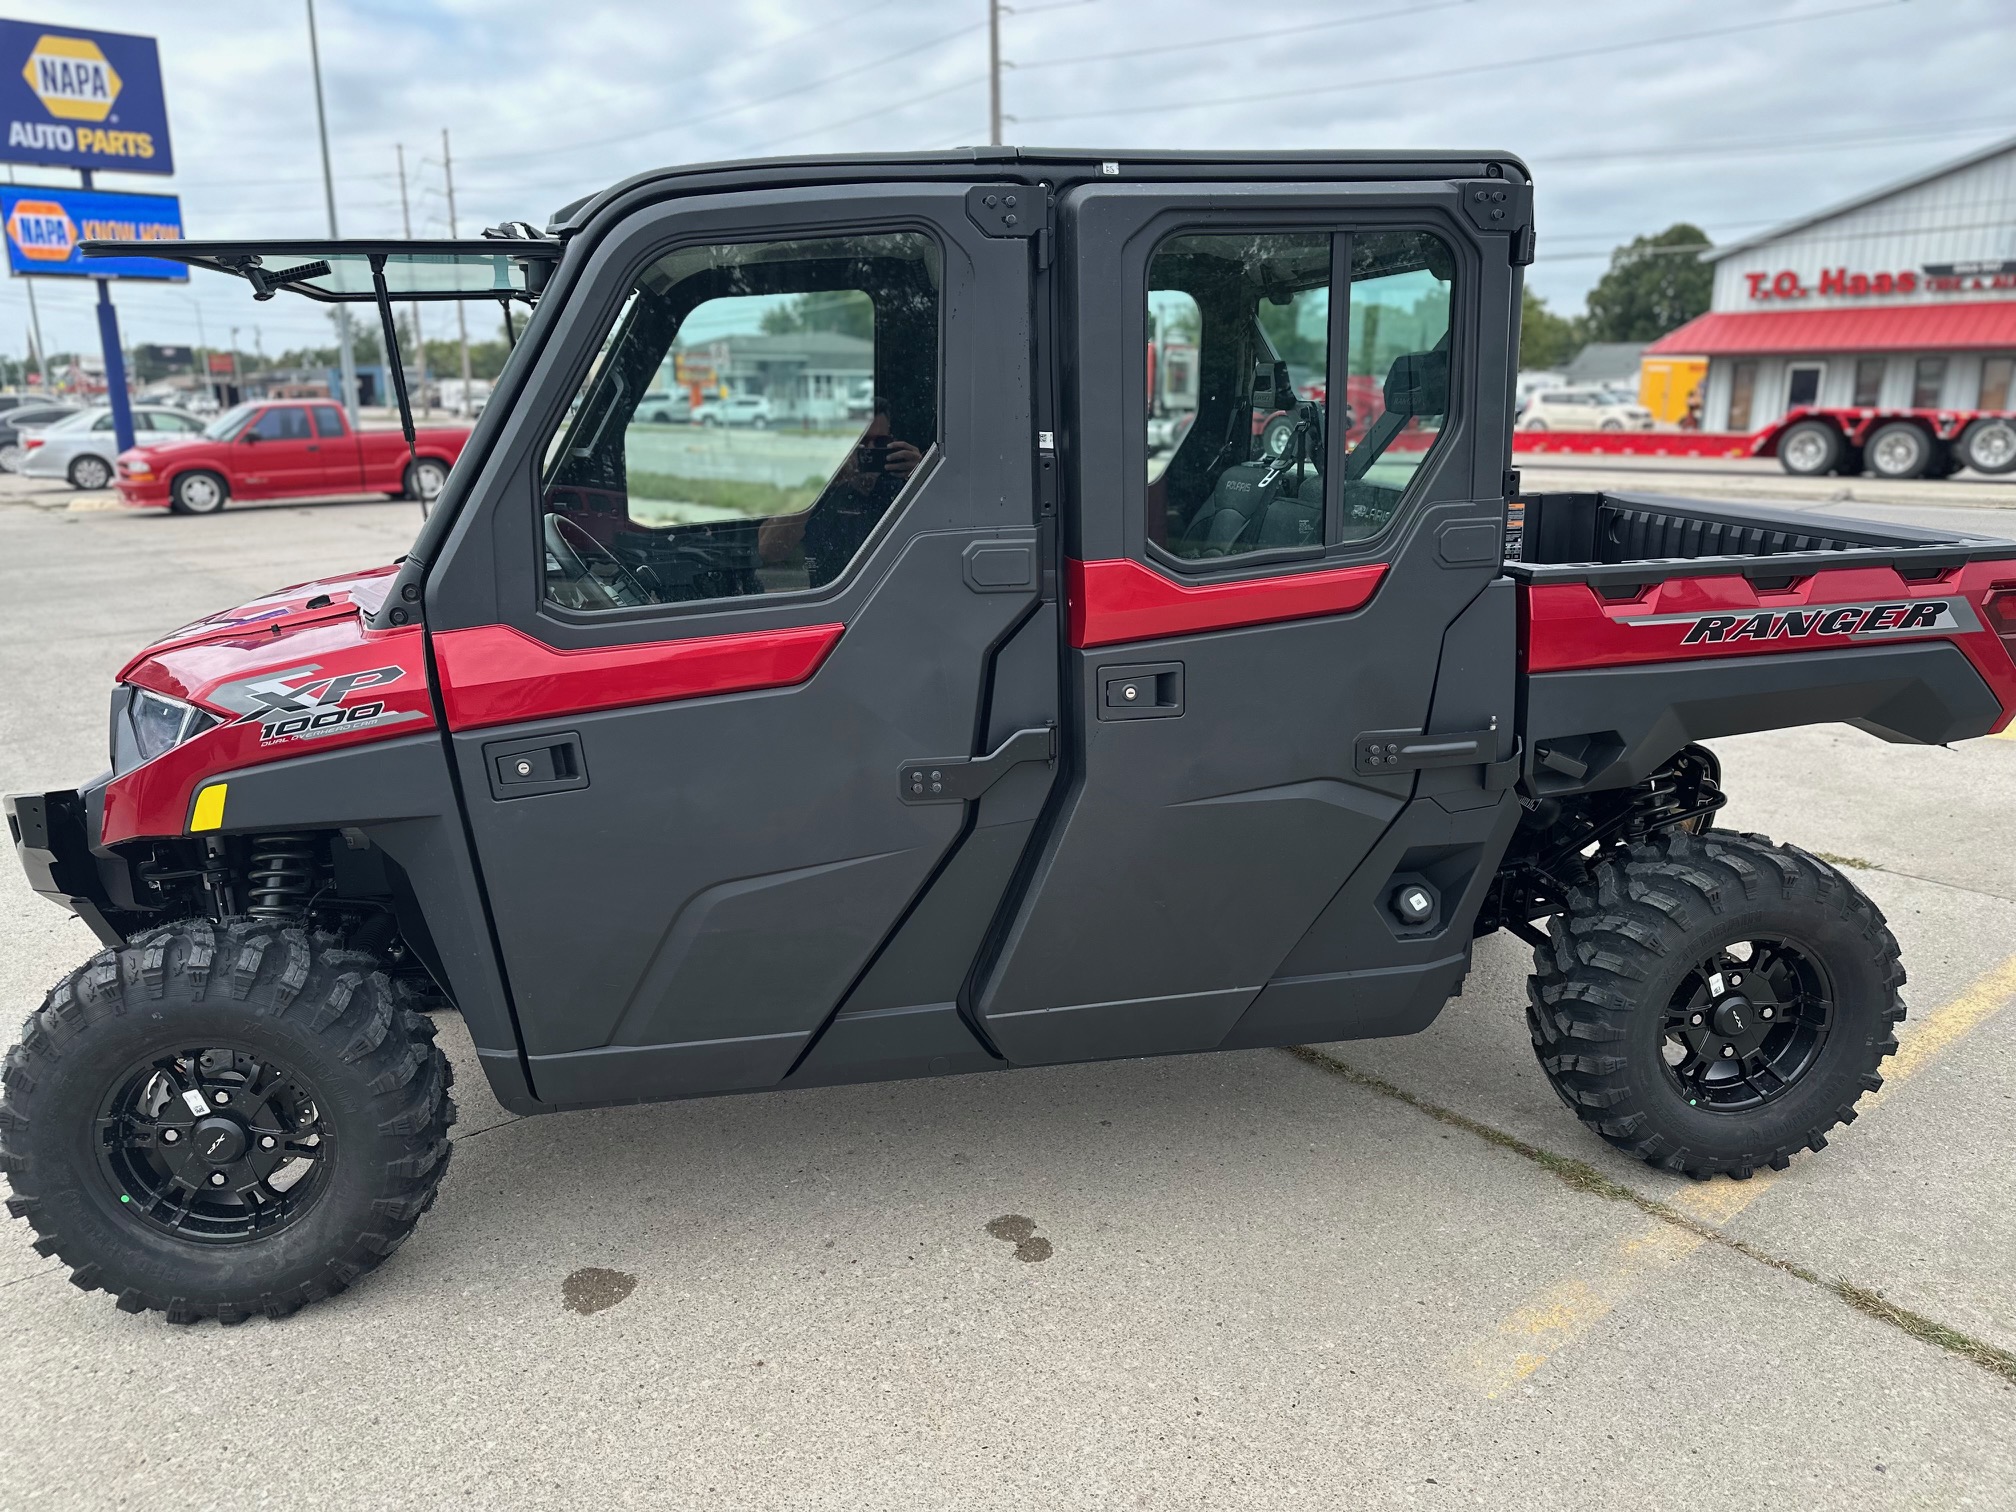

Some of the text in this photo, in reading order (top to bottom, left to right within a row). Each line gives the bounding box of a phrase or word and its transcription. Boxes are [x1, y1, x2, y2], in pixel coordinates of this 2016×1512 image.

[40, 60, 108, 99] NAPA
[9, 121, 154, 158] AUTO PARTS
[20, 217, 68, 245] NAPA
[1745, 267, 1917, 299] T.O. Haas
[1681, 601, 1950, 645] RANGER
[228, 664, 407, 727] XP
[259, 701, 385, 741] 1000
[261, 719, 378, 747] DUAL OVERHEAD CAM
